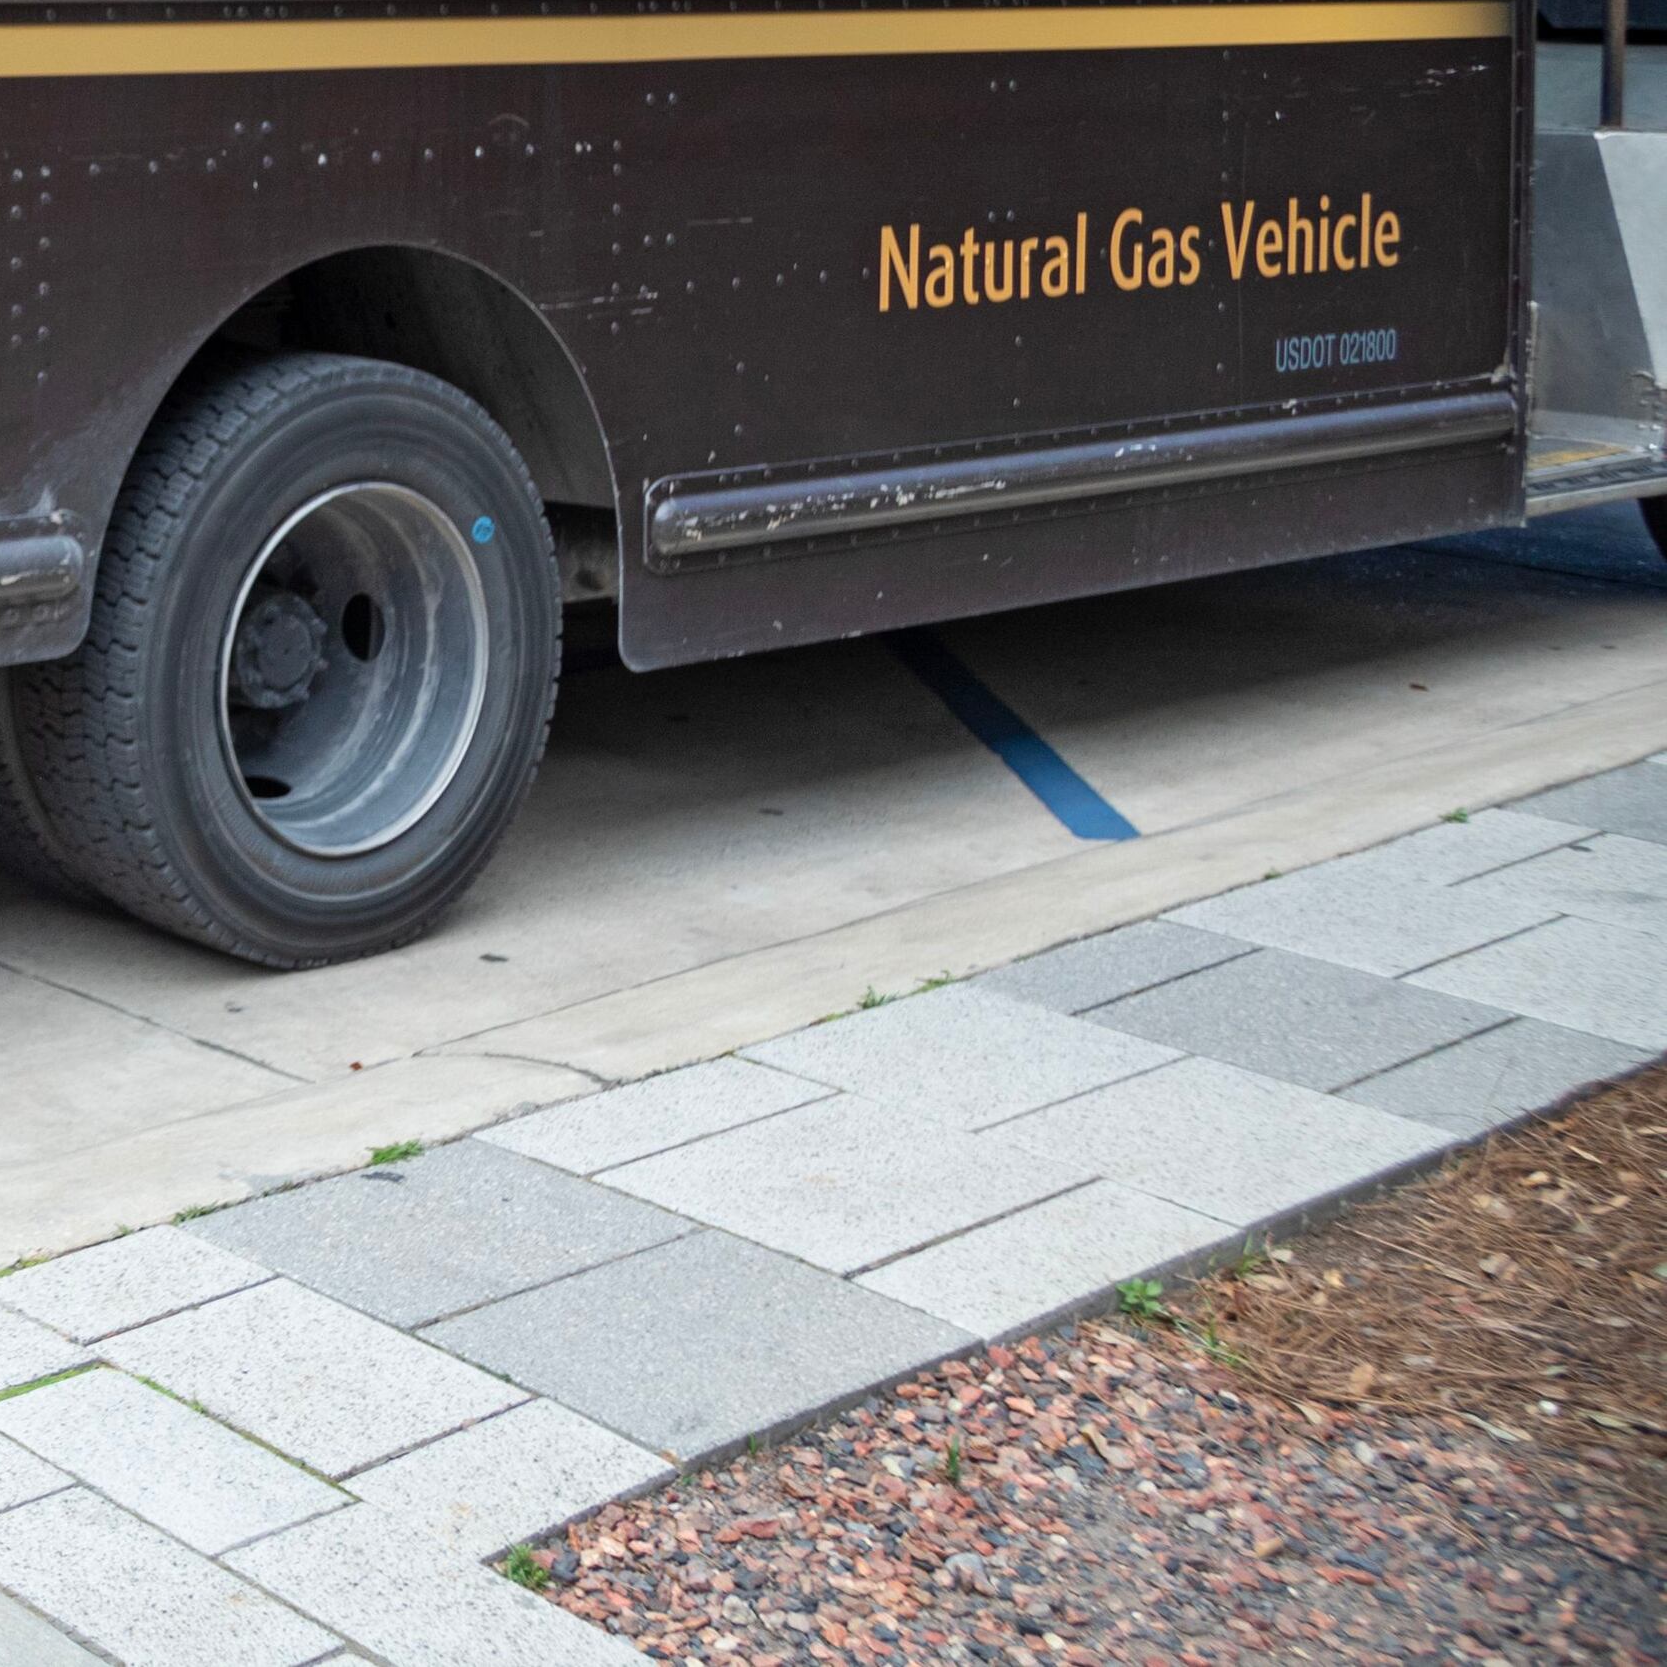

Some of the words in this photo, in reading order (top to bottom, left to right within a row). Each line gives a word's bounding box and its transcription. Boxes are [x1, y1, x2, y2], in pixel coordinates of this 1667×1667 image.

[878, 212, 1087, 311] Natural
[1109, 207, 1201, 292] Gas
[1220, 192, 1401, 280] Vehicle
[1275, 333, 1336, 373] USDOT
[1339, 328, 1397, 366] 021800
